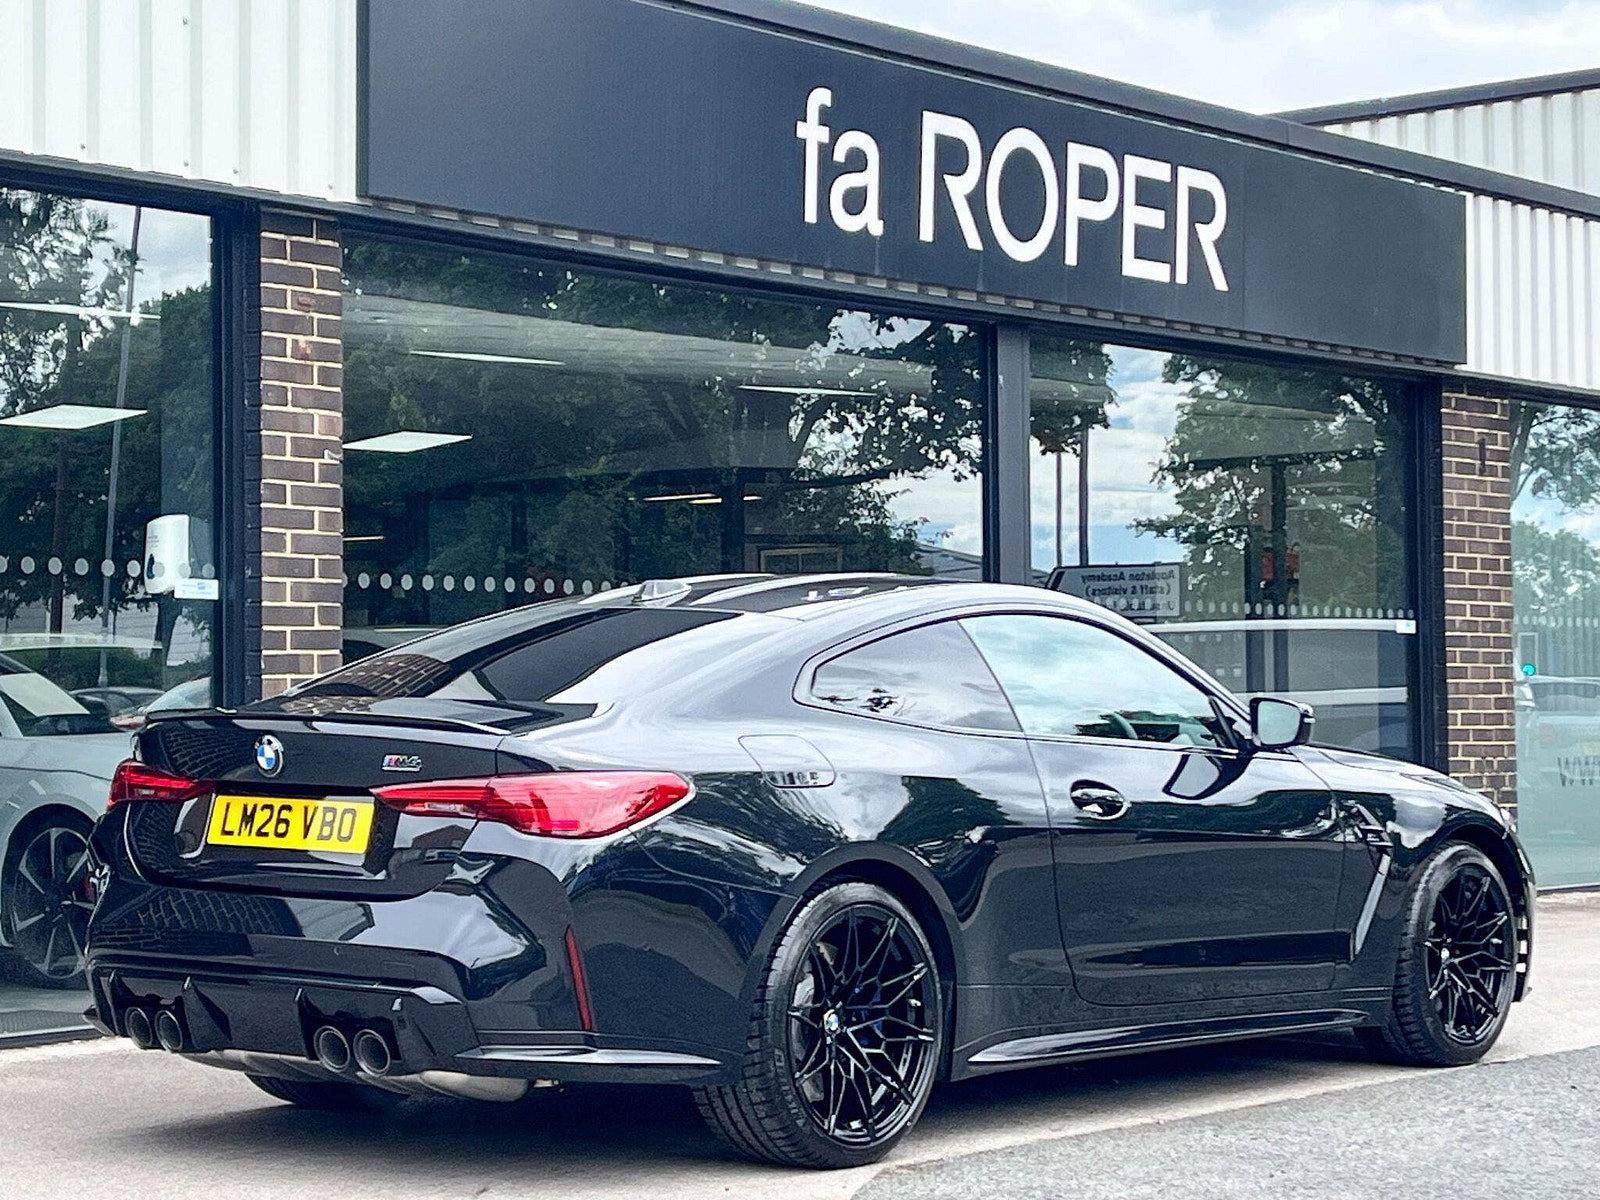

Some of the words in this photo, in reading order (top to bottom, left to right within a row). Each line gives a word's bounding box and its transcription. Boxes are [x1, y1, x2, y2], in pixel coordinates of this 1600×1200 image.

[795, 86, 884, 236] fa
[917, 109, 1229, 291] ROPER
[220, 801, 293, 838] LM26
[302, 805, 358, 842] VBO
